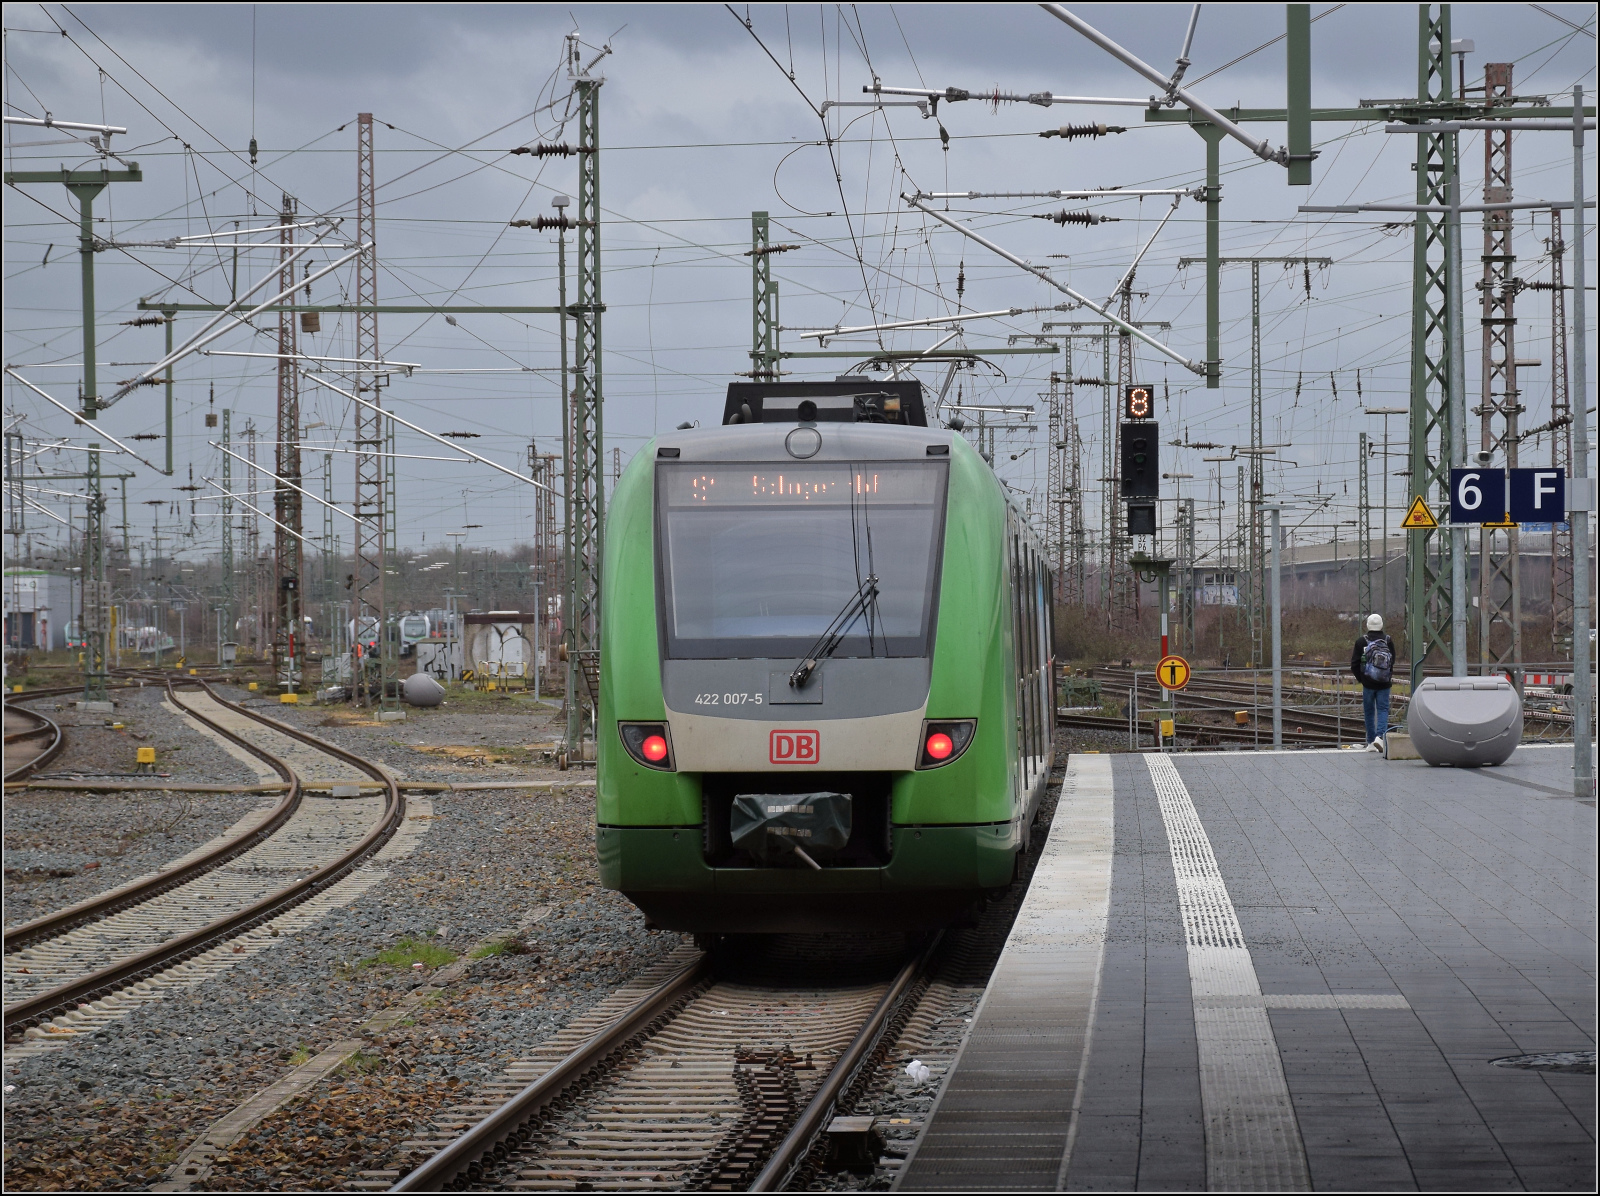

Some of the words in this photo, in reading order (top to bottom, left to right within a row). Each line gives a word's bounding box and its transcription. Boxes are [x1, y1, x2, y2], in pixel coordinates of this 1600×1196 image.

[1131, 388, 1148, 415] 8
[1458, 473, 1482, 510] 6
[1534, 472, 1557, 509] F
[1138, 543, 1146, 551] P6
[695, 693, 719, 705] 422
[723, 693, 763, 705] 007-5
[776, 735, 814, 759] DB
